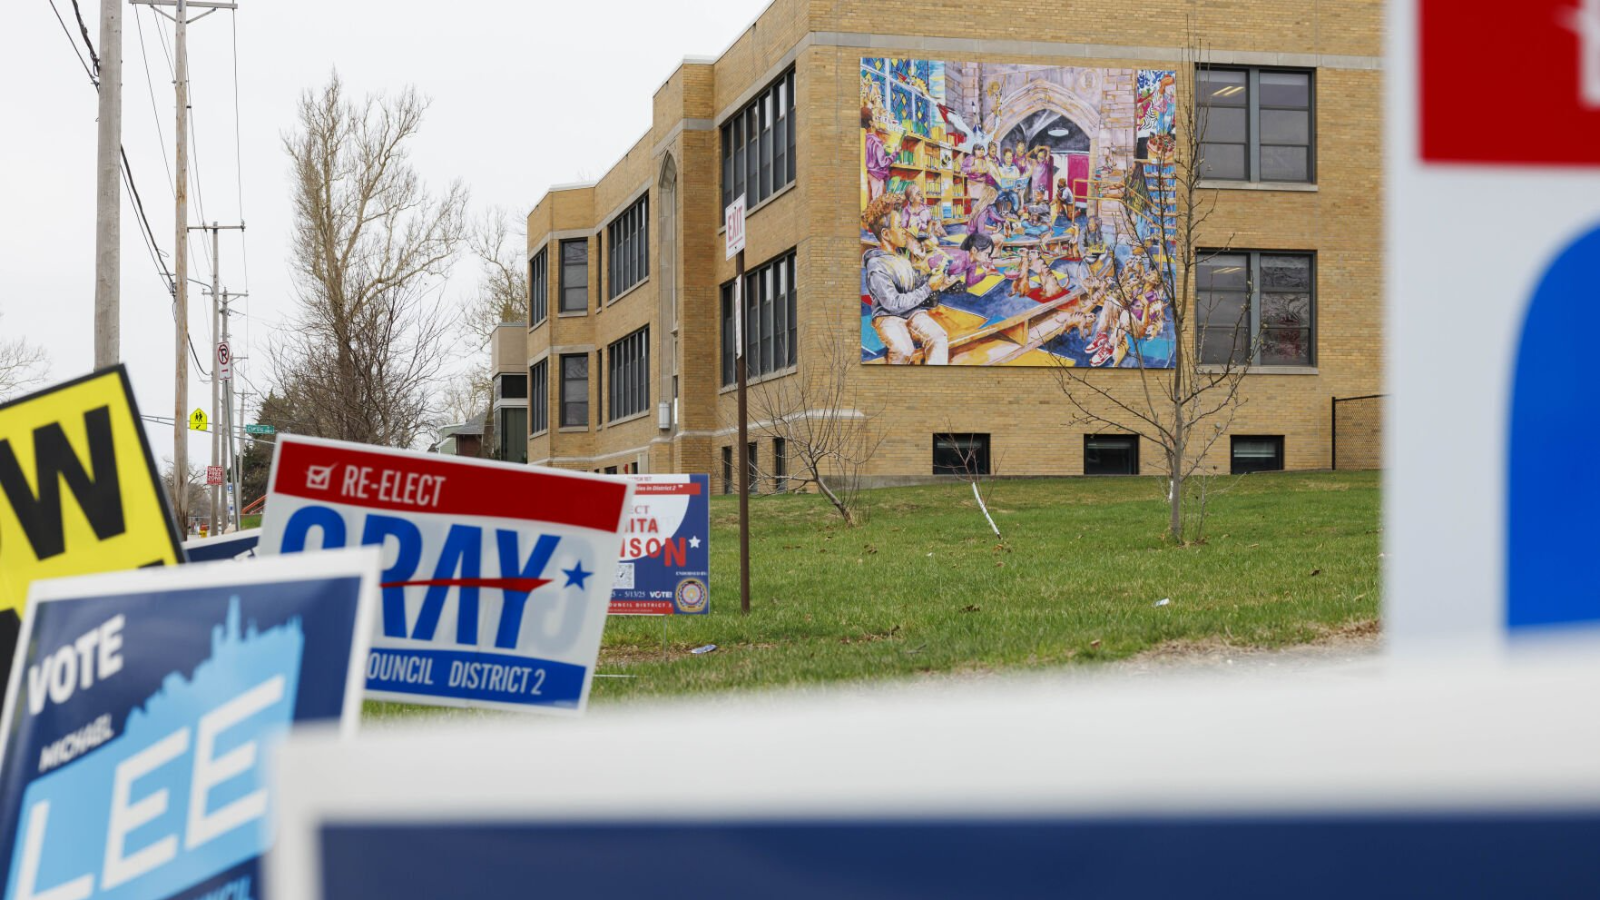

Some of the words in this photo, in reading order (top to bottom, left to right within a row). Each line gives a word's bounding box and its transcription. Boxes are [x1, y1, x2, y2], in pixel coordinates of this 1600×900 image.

[728, 205, 743, 243] EXIT
[0, 405, 126, 561] W
[341, 464, 446, 508] RE-ELECT
[625, 518, 658, 533] ITA
[649, 590, 673, 599] VOTE!
[28, 613, 125, 716] VOTE
[448, 660, 532, 694] DISTRICT
[531, 668, 547, 696] 2
[38, 713, 115, 773] MICHAEL
[13, 674, 286, 900] LEE
